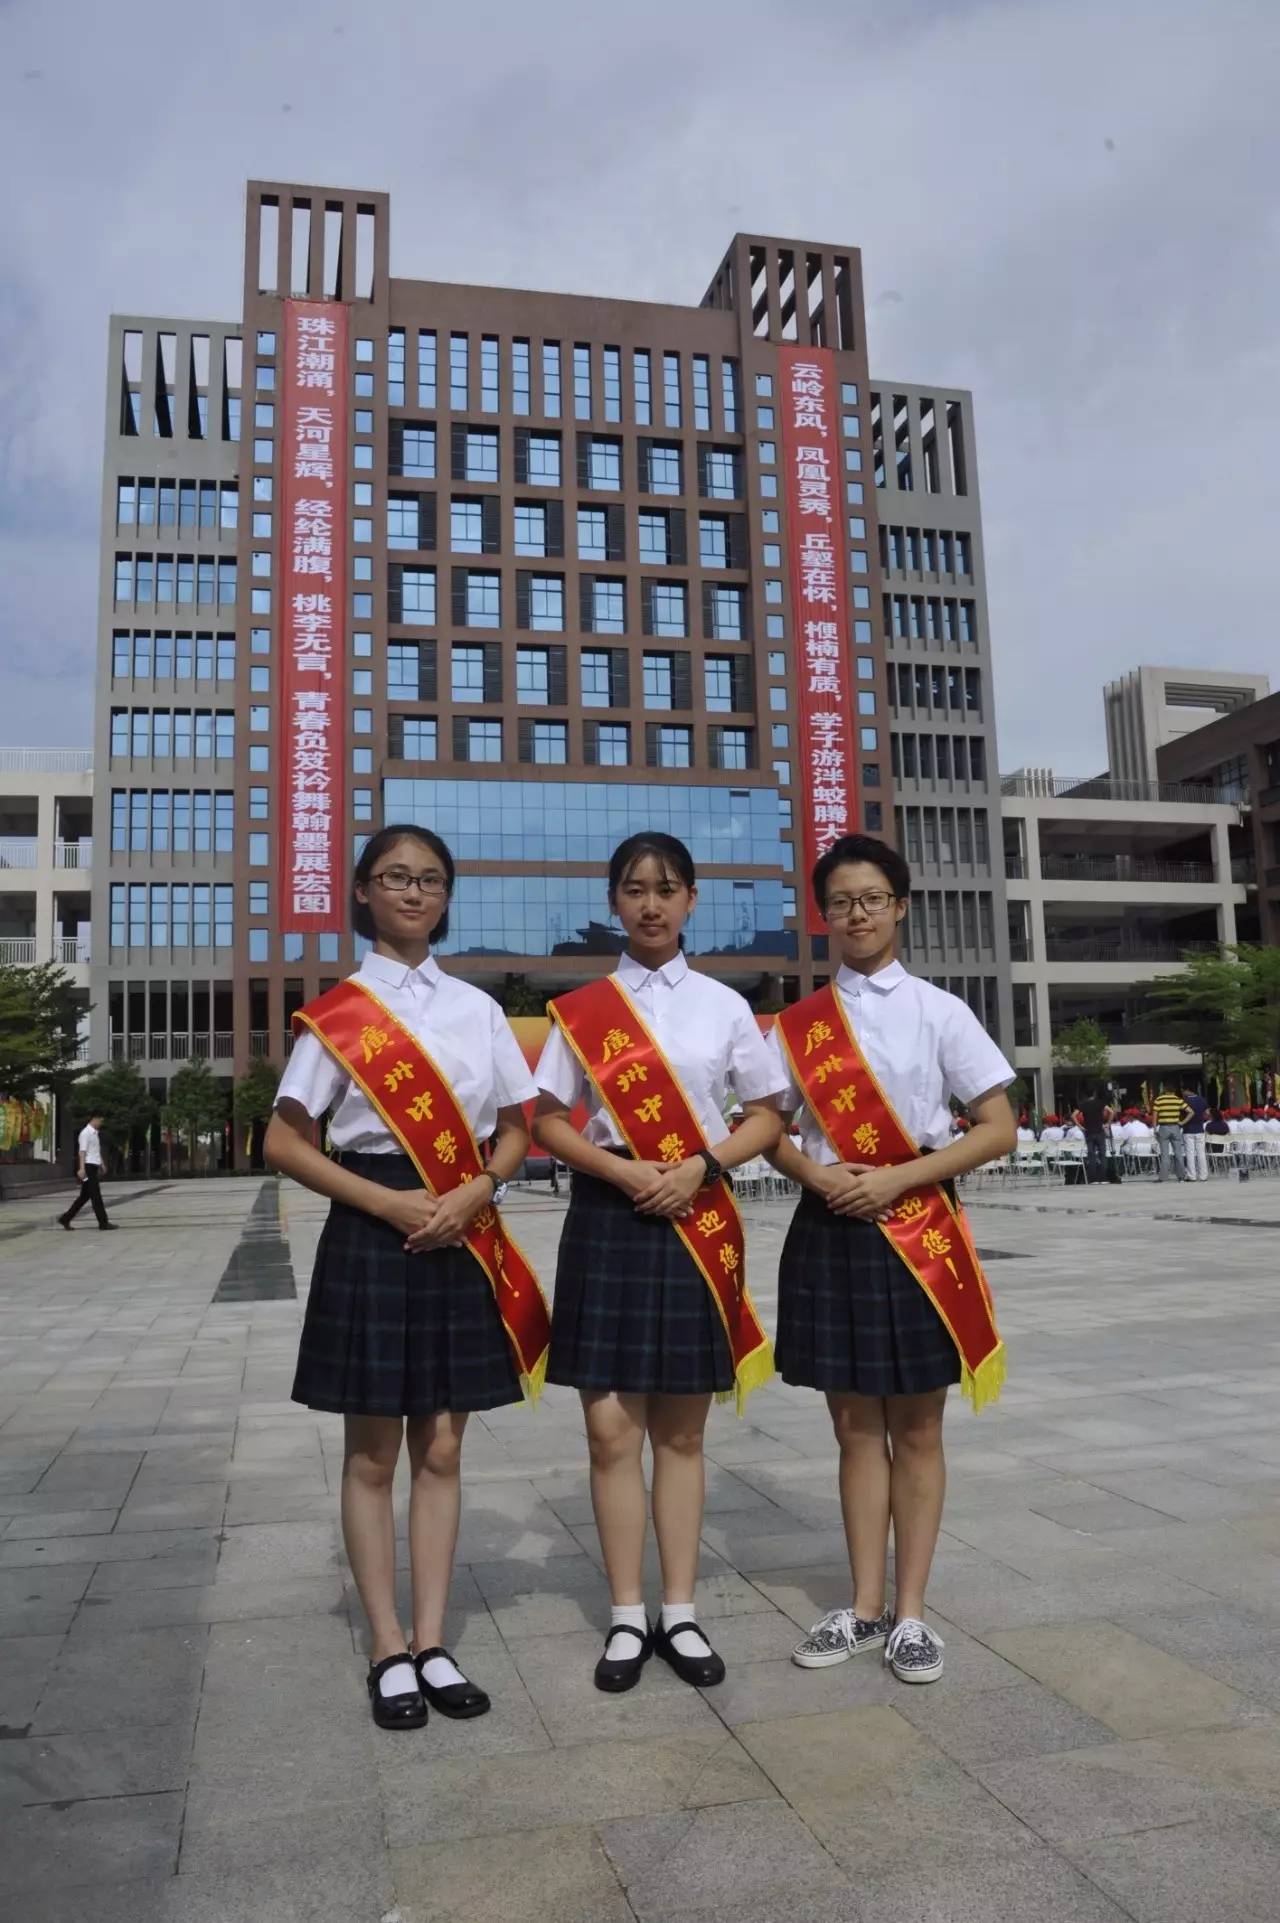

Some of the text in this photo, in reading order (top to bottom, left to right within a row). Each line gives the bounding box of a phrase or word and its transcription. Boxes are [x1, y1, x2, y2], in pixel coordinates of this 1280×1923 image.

[791, 362, 848, 859] 云岭东风，凤凰灵秀，丘壑在怀，楩楠有质，学子游泮蛟腾大
[359, 1024, 520, 1298] 廣州中學迎您！
[601, 1028, 740, 1303] 廣州中學迎您！
[805, 1020, 965, 1291] 廣州中學迎您！
